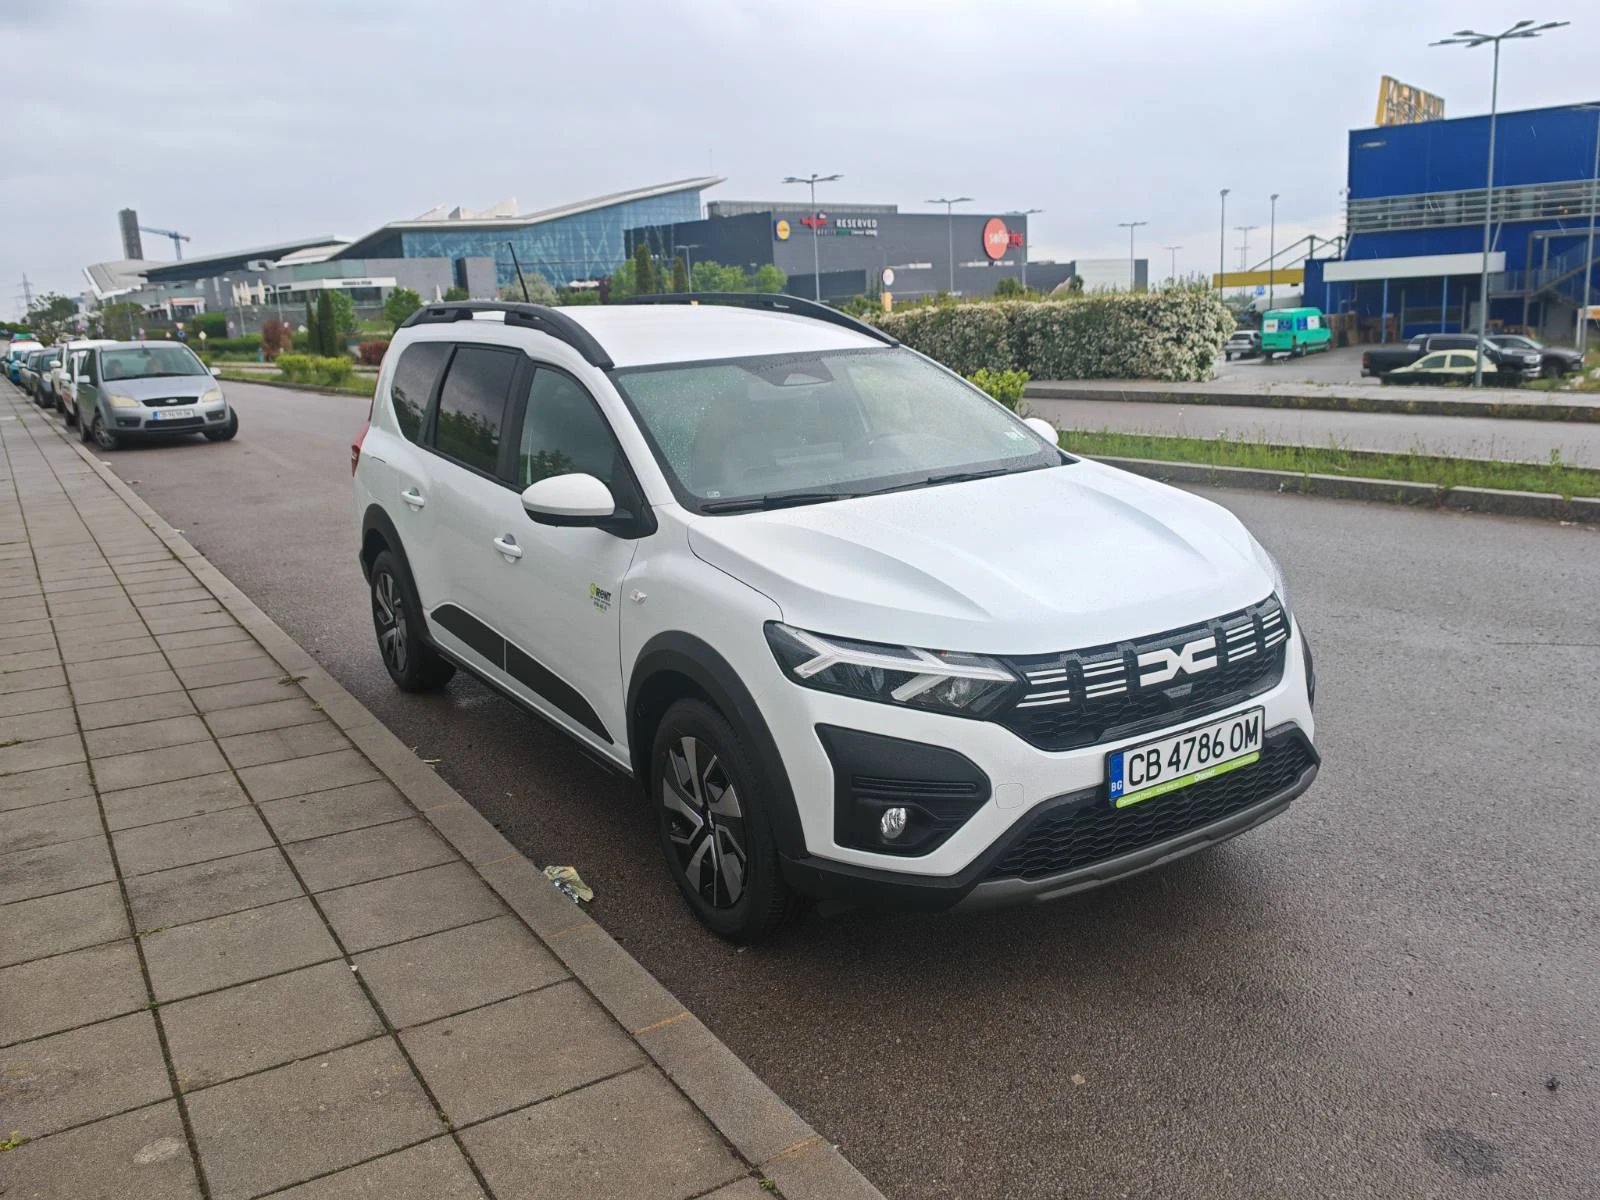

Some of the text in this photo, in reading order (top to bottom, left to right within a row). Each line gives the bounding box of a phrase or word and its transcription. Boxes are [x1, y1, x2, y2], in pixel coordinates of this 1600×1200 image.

[836, 219, 877, 228] RESERVED
[1128, 715, 1259, 787] CB 4786 OM
[1111, 779, 1123, 792] BG
